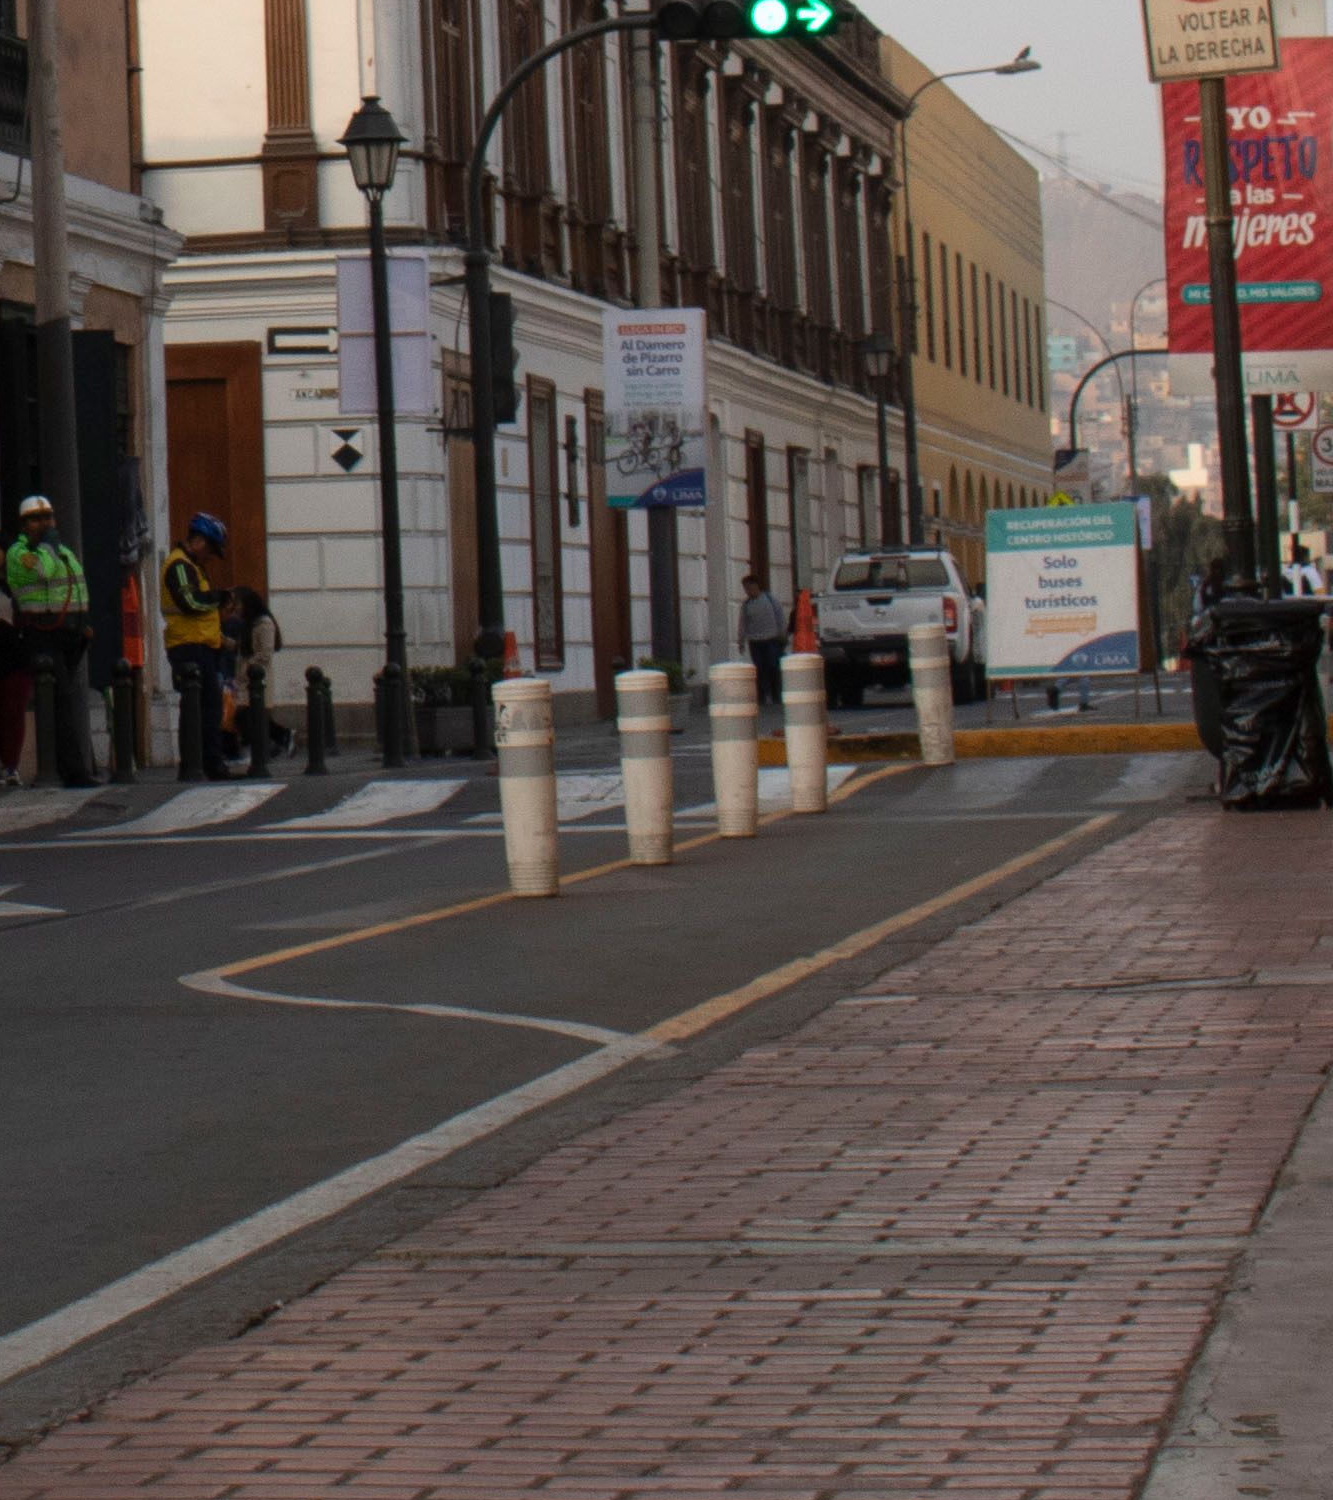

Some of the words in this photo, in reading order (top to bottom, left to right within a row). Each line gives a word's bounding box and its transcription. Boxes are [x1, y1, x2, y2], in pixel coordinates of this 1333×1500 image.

[1178, 8, 1251, 32] VOLTEAR
[1258, 6, 1268, 24] A
[1158, 46, 1179, 64] LA
[1185, 37, 1265, 62] DERECHA
[1225, 106, 1272, 131] YO
[1184, 135, 1318, 187] RSPETO
[1246, 184, 1275, 205] las
[1183, 208, 1318, 261] mjeres
[621, 339, 633, 350] Al
[636, 340, 685, 351] Damero
[622, 353, 638, 363] de
[641, 352, 683, 363] Pizarro
[626, 365, 643, 376] sin
[646, 365, 681, 376] Carro
[1246, 369, 1301, 385] LIMA
[1322, 436, 1333, 453] 3
[1092, 515, 1113, 526] DEL
[1007, 533, 1052, 545] CENTRO
[1043, 555, 1076, 570] Solo
[1038, 575, 1082, 590] buses
[1025, 594, 1098, 609] turísticos
